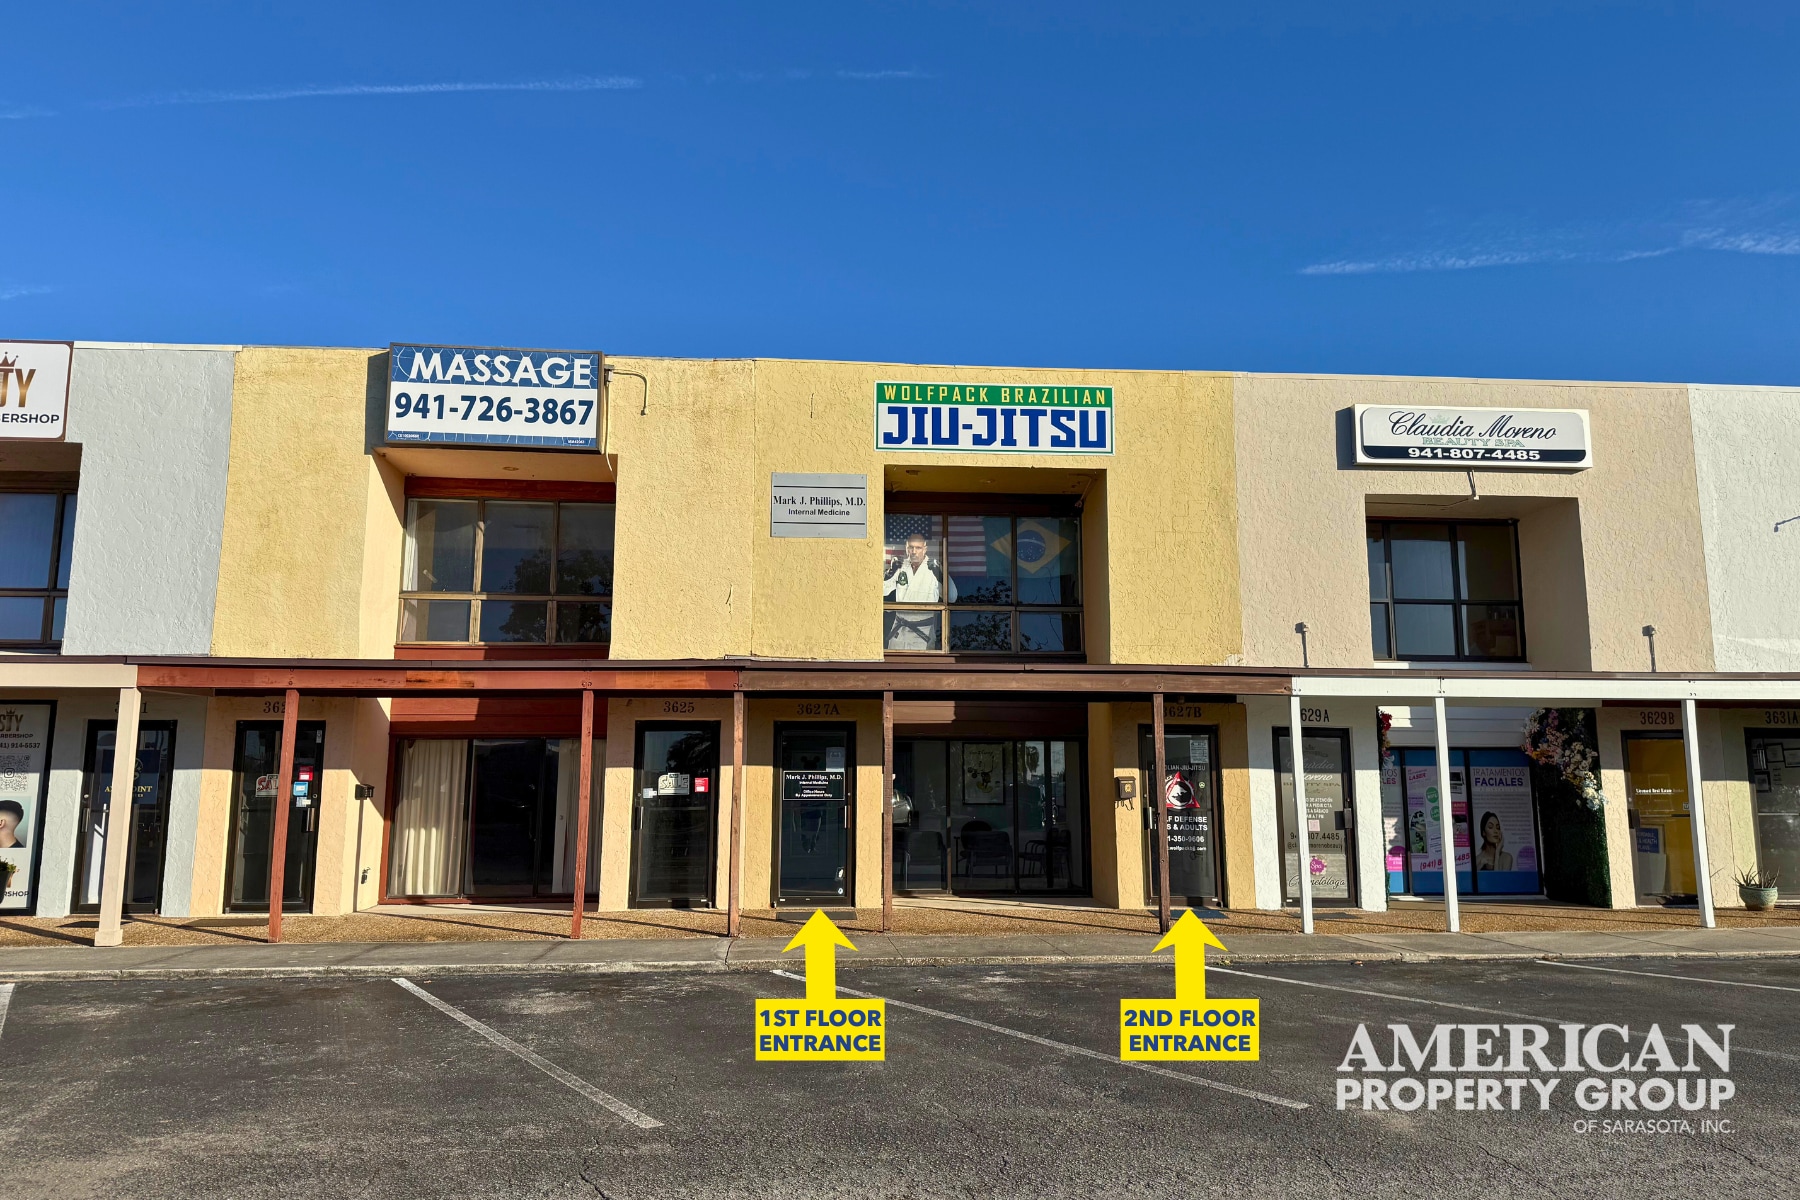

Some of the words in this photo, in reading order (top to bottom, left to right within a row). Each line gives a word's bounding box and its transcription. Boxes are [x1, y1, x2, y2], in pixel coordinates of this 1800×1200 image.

[409, 352, 592, 386] MASSAGE
[884, 385, 989, 403] WOLFPACK
[1001, 388, 1105, 405] BRAZILIAN
[394, 392, 594, 425] 941-726-3867
[0, 413, 60, 424] ERSHOP
[1388, 410, 1475, 437] Claudia
[1478, 414, 1557, 440] Moreno
[883, 406, 1107, 448] JIU-JITSU
[1422, 436, 1491, 447] BEAUTY
[1494, 438, 1526, 448] SPA
[1407, 447, 1541, 460] 941-807-4485
[773, 495, 797, 505] Mark
[799, 496, 807, 505] J.
[809, 496, 843, 508] Phillips,
[845, 497, 866, 506] M.D.
[788, 508, 816, 516] Internal
[817, 508, 851, 516] Medicine
[663, 700, 695, 714] 3625
[796, 702, 840, 716] 3627A
[1300, 708, 1330, 723] 629A
[1640, 711, 1675, 725] 3629B
[1473, 768, 1526, 777] TRATAMIENTOS
[660, 778, 689, 789] SALE
[1474, 777, 1524, 787] FACIALES
